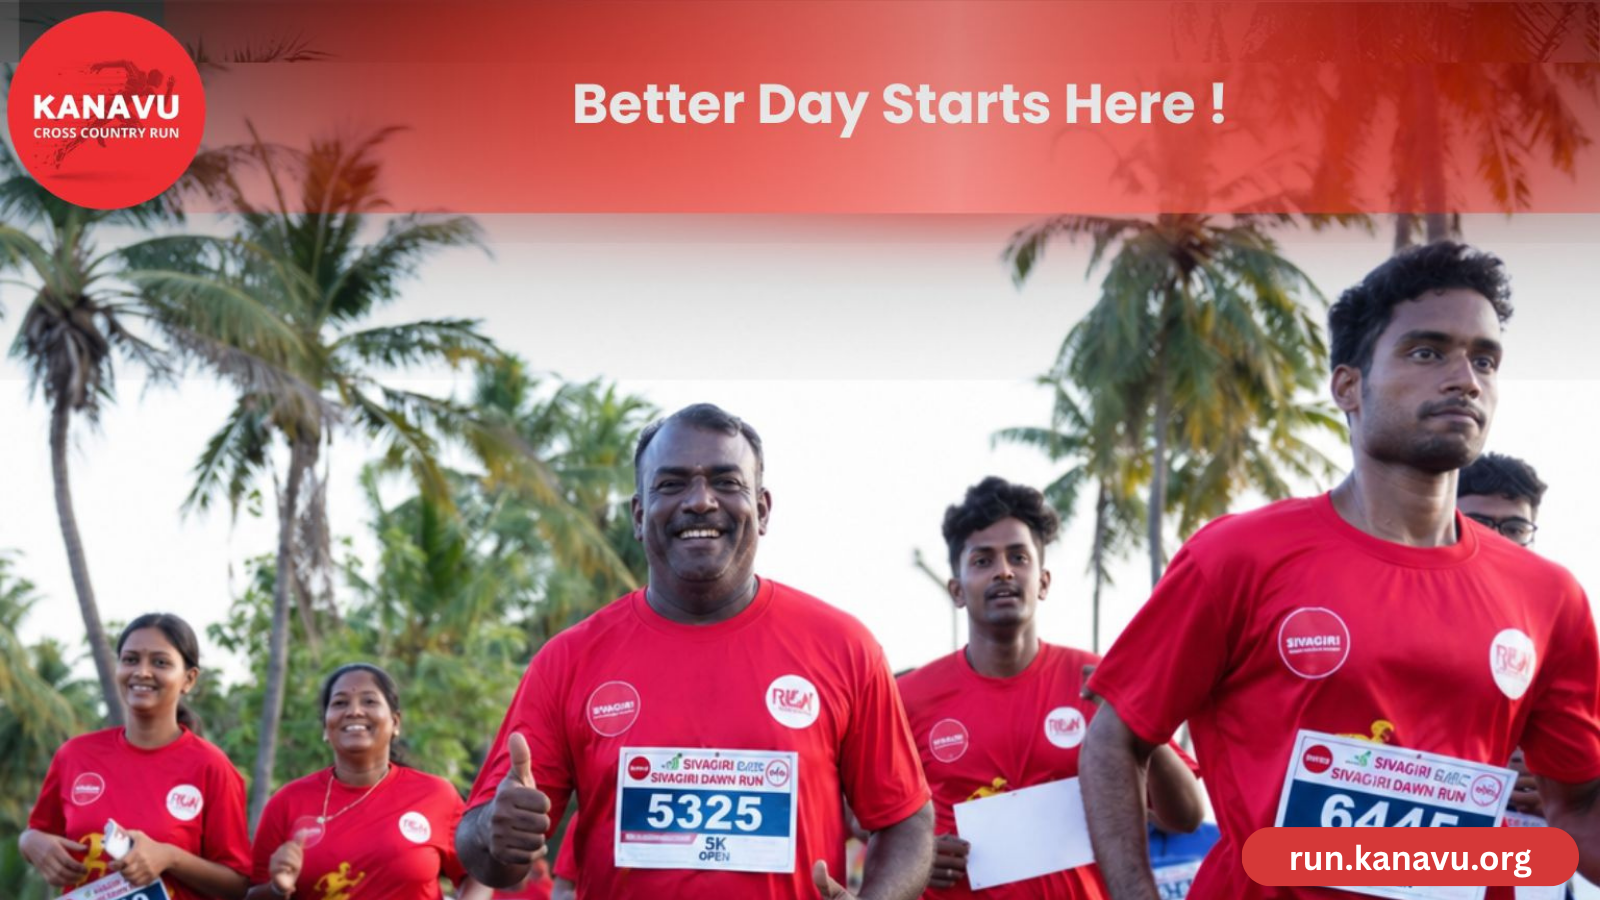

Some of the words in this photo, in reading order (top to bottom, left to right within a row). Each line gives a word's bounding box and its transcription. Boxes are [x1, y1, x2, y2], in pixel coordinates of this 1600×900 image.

[683, 759, 735, 771] SIVAGIRI
[650, 772, 699, 785] SIVAGIRI
[701, 774, 737, 786] DAWN
[739, 775, 764, 787] RUN
[1392, 780, 1435, 798] DAWN
[1437, 787, 1468, 803] RUN
[646, 793, 763, 832] 5325
[699, 850, 731, 861] OPEN
